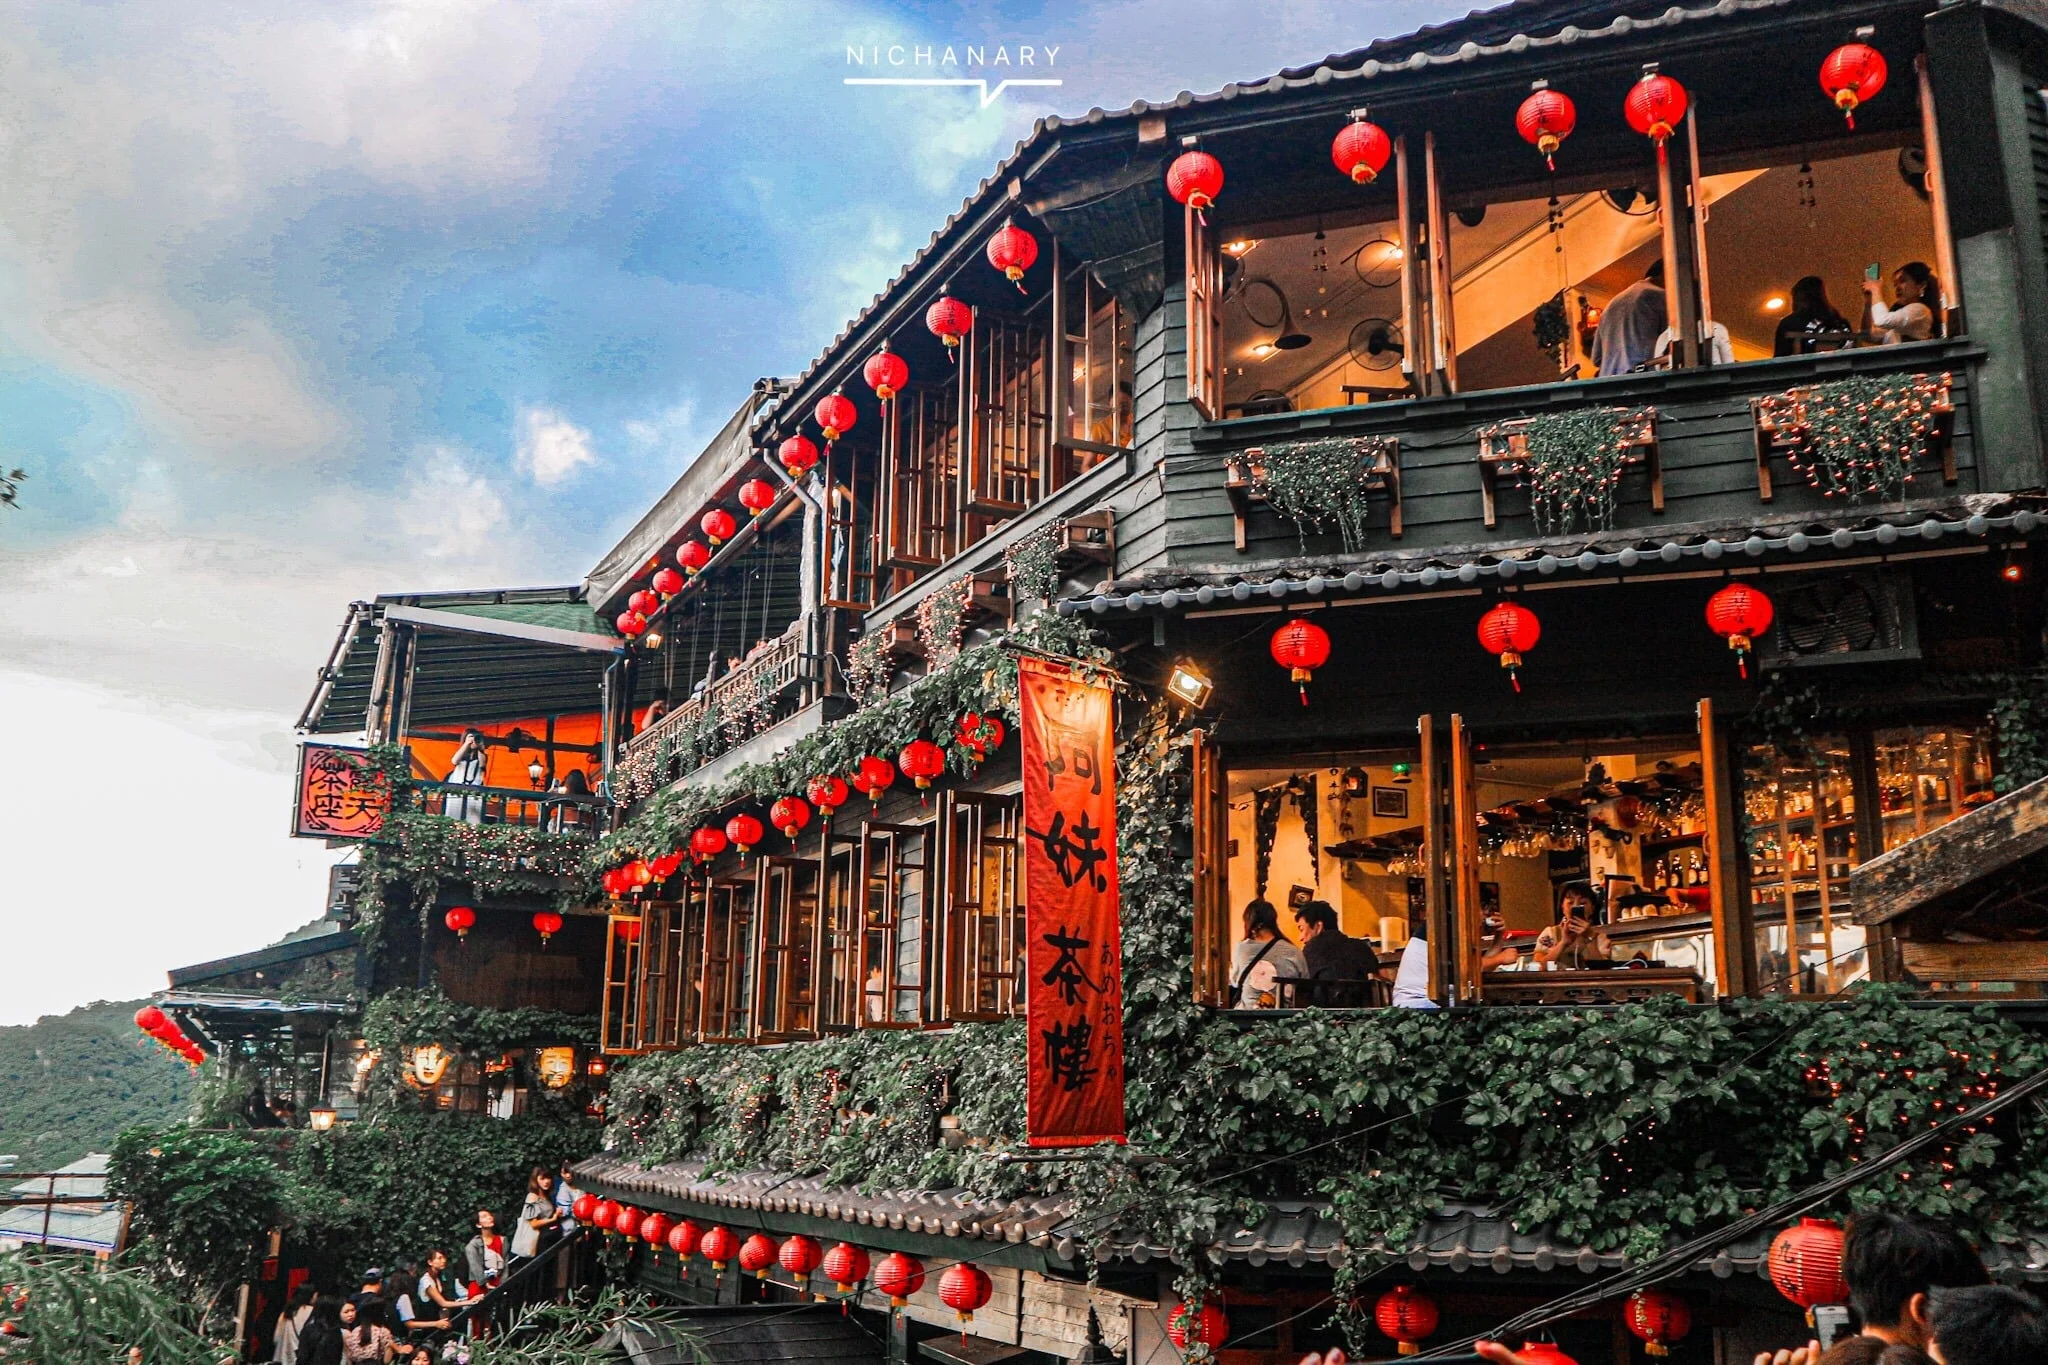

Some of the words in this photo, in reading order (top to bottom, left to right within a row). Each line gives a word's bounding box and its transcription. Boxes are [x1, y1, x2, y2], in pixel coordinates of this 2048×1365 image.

[1026, 730, 1107, 1092] 阿妹茶樓
[1100, 942, 1118, 1082] あめおちゃ
